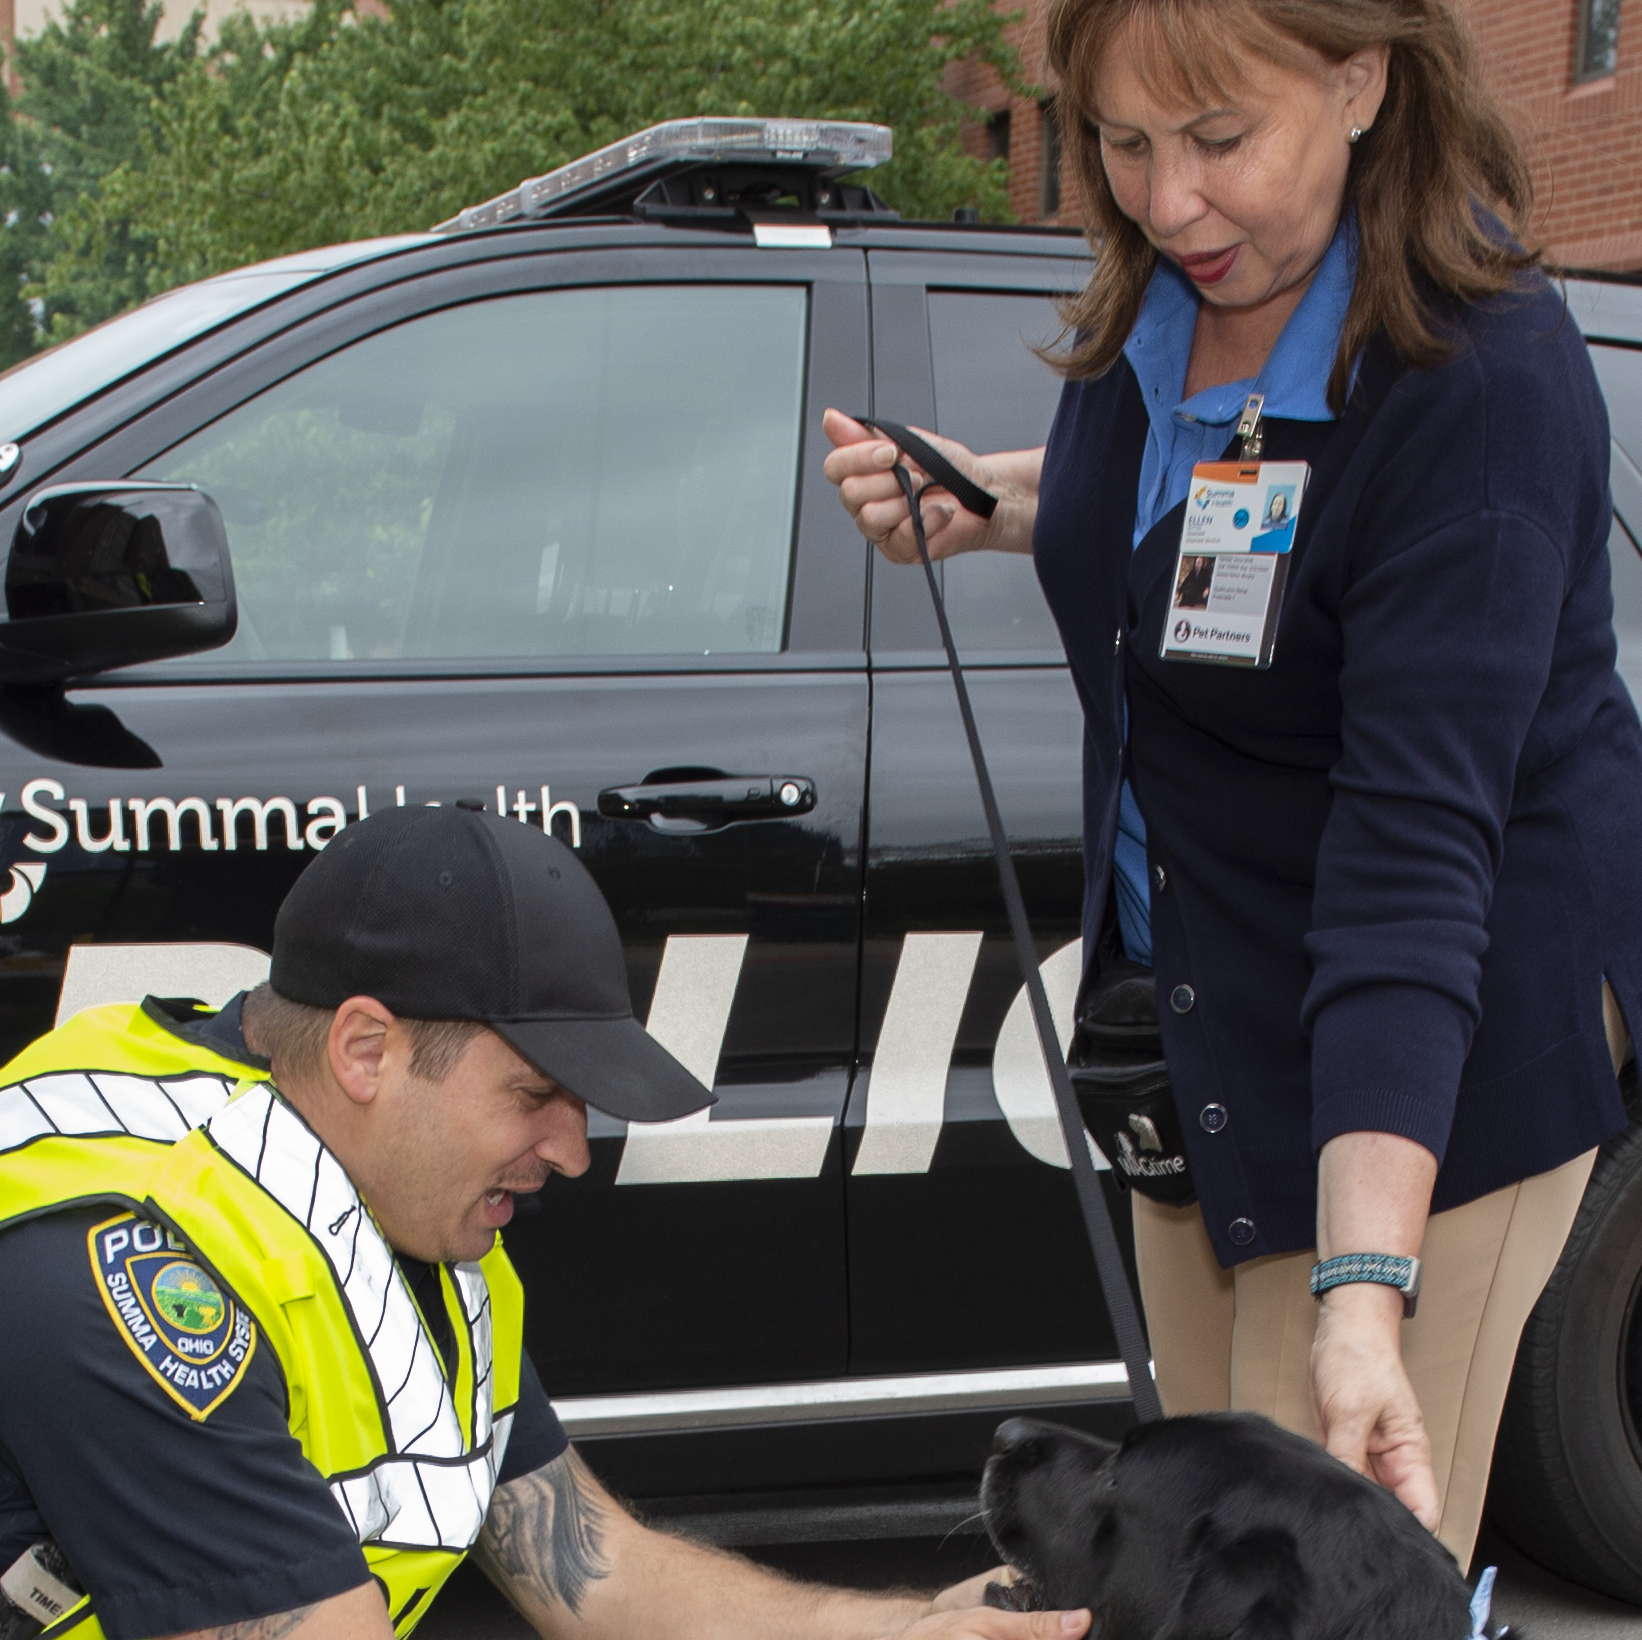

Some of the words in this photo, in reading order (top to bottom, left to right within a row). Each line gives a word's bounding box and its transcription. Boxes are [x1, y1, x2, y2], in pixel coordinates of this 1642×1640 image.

[1192, 626, 1208, 640] Pet
[1210, 627, 1251, 643] Partners
[103, 1220, 186, 1264] POL
[107, 1272, 158, 1352] SUMMA
[158, 1354, 236, 1390] HEALTH
[177, 1337, 214, 1355] OHIO
